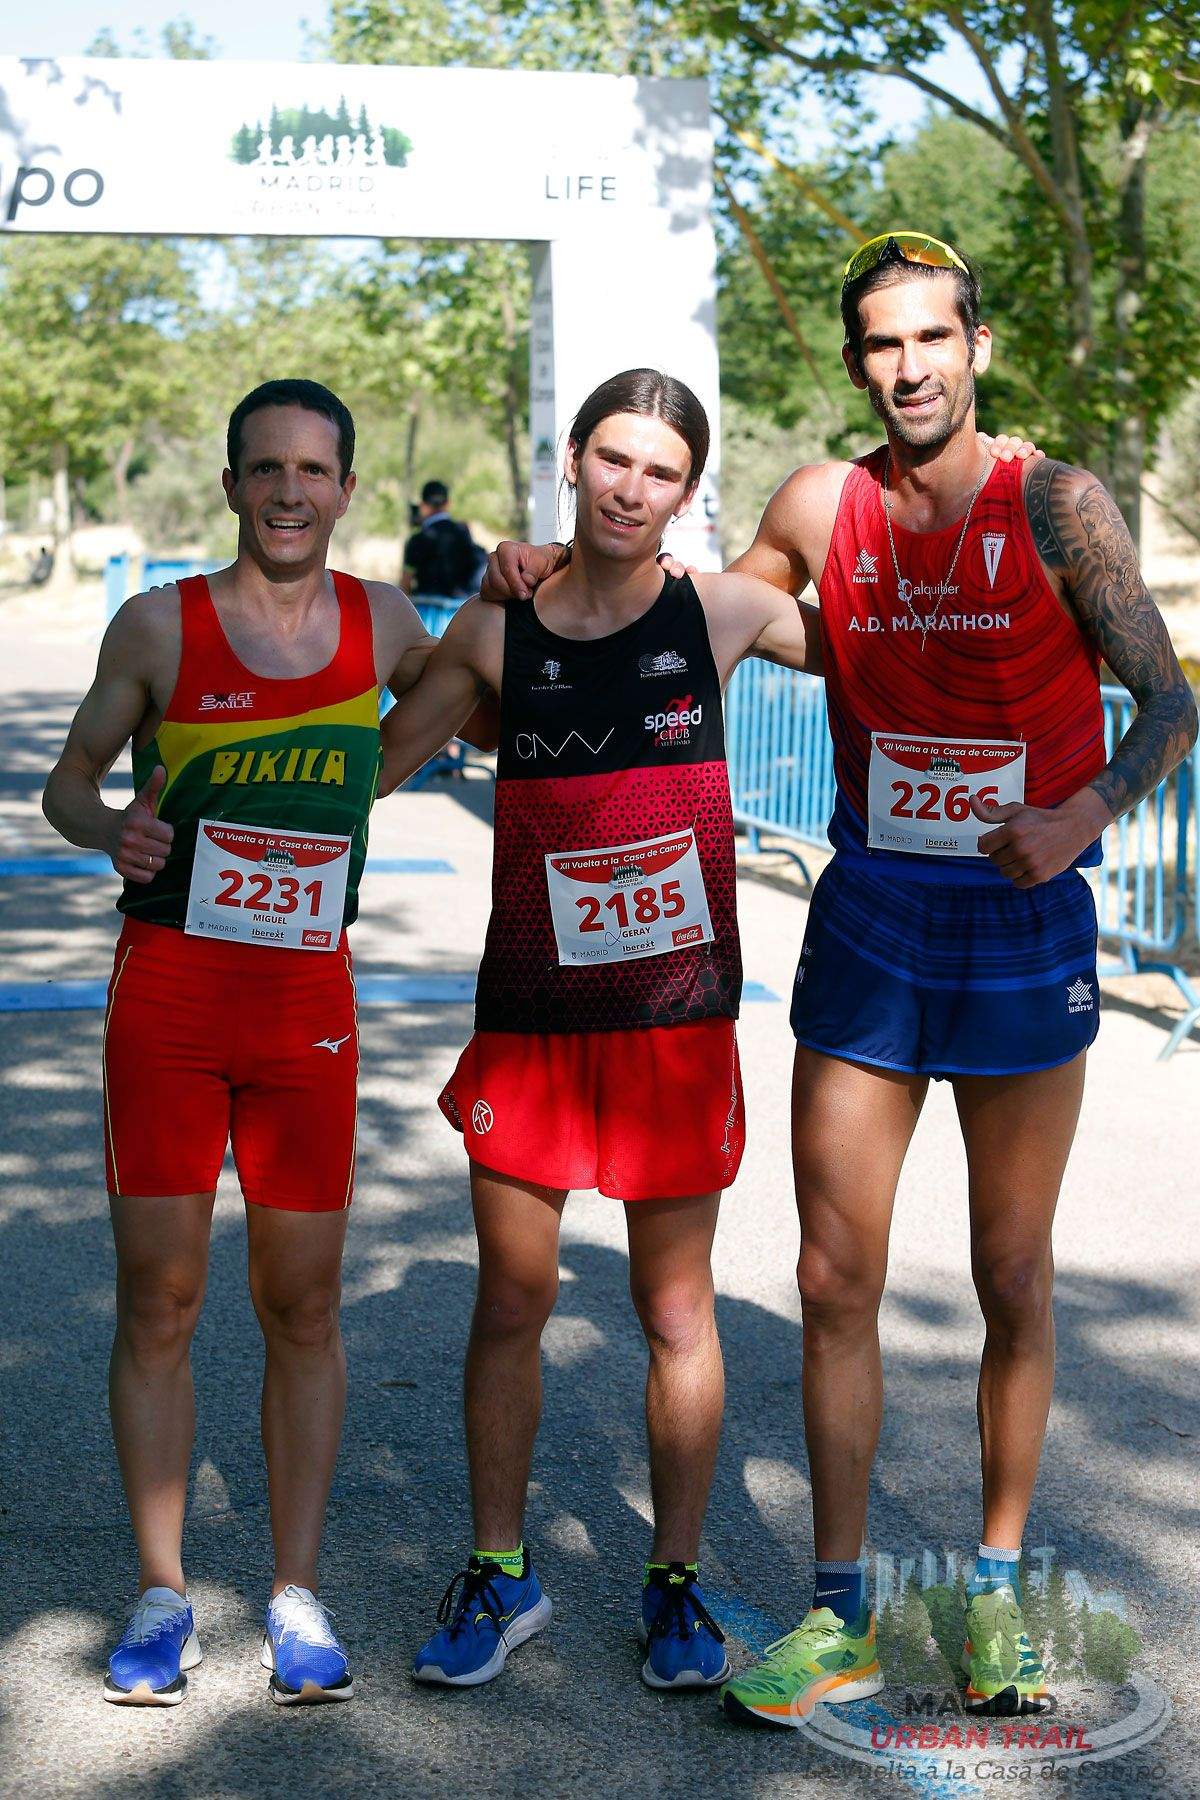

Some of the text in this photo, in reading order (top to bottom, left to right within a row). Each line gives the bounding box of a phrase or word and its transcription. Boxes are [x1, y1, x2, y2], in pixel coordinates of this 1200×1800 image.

[260, 175, 375, 193] MADRID
[545, 174, 616, 201] LIFE
[4, 166, 104, 222] po
[913, 580, 960, 601] alquiber
[848, 613, 1011, 632] A.D. MARATHON
[644, 704, 702, 733] speed
[660, 728, 690, 740] CLUB
[882, 742, 894, 751] XII
[895, 743, 921, 753] Vuelta
[930, 746, 939, 754] la
[943, 747, 966, 756] Casa
[968, 748, 980, 757] de
[982, 749, 1016, 758] Campo
[209, 747, 346, 786] BIKILA
[211, 830, 225, 840] XII
[226, 832, 256, 844] Vuelta
[265, 837, 275, 846] la
[279, 839, 301, 850] Casa
[302, 842, 314, 851] de
[314, 843, 343, 854] Campo
[887, 835, 913, 844] MADRID
[925, 838, 959, 847] Iberext
[559, 862, 570, 870] XII
[571, 860, 601, 869] Vuelta
[610, 857, 620, 865] la
[623, 853, 646, 863] Casa
[647, 849, 658, 858] de
[659, 841, 689, 855] Campo
[214, 869, 324, 917] 2231
[575, 880, 686, 933] 2185
[252, 914, 288, 925] MIGUEL
[207, 923, 238, 934] MADRID
[252, 928, 285, 939] Iberext
[622, 927, 651, 939] GERAY
[580, 949, 609, 958] MADRID
[622, 940, 655, 952] Iberext
[1067, 1001, 1094, 1014] luanvi
